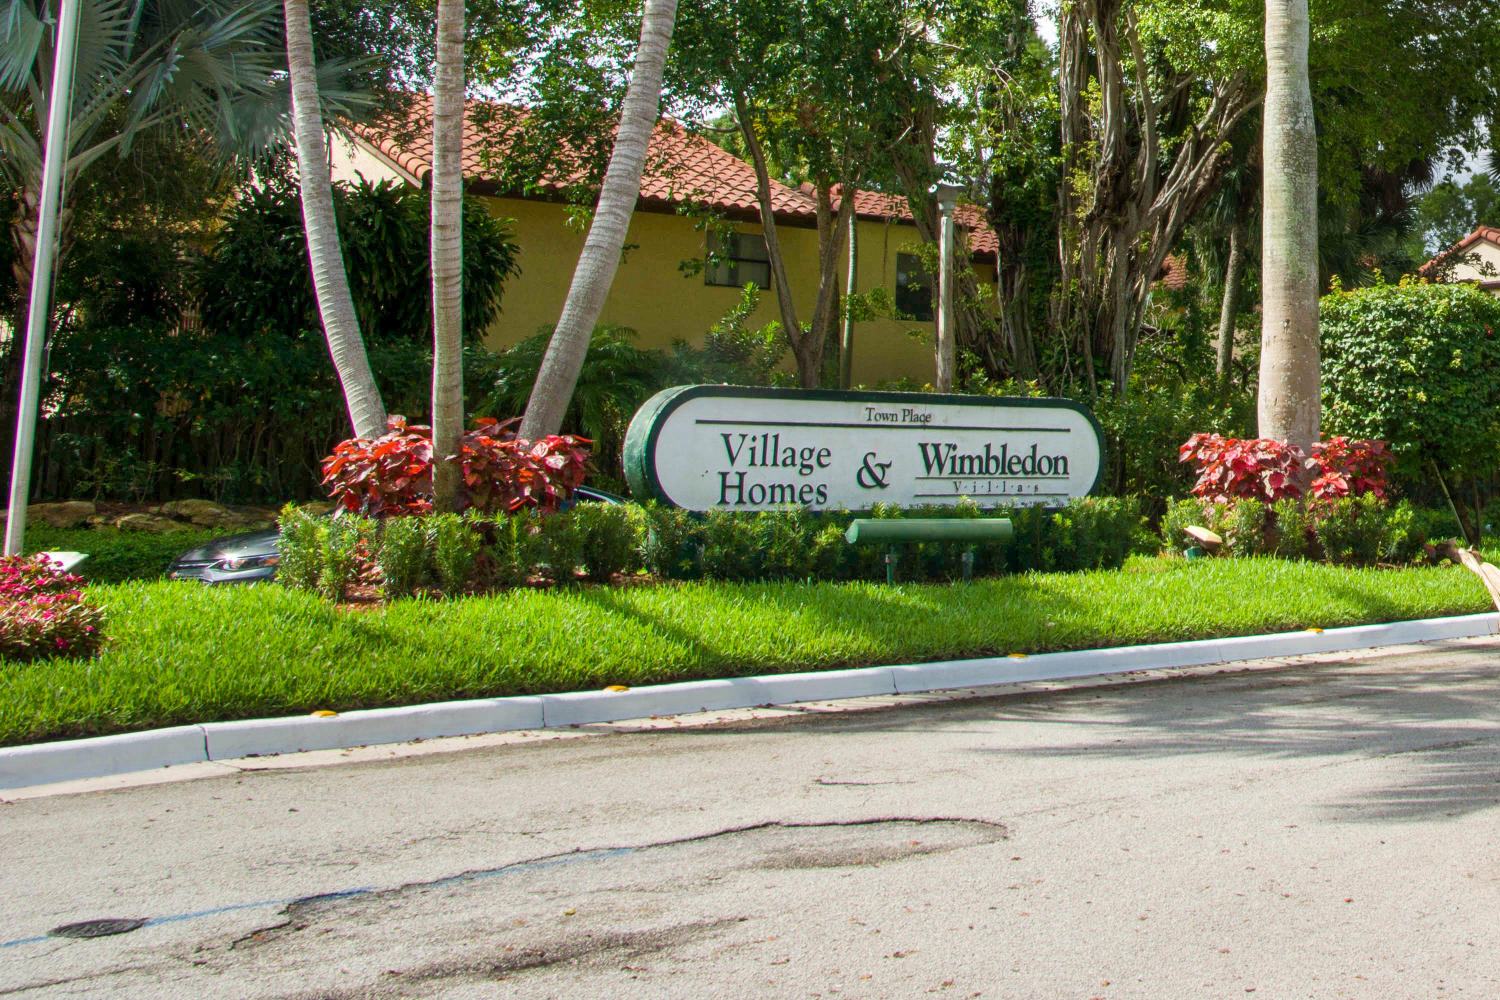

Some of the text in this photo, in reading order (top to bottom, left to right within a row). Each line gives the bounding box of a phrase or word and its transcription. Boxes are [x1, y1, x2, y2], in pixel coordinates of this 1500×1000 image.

[866, 407, 932, 423] Town Place
[721, 433, 832, 476] Village
[857, 452, 892, 490] &
[918, 442, 1070, 476] Wimbledon
[717, 471, 828, 507] Homes
